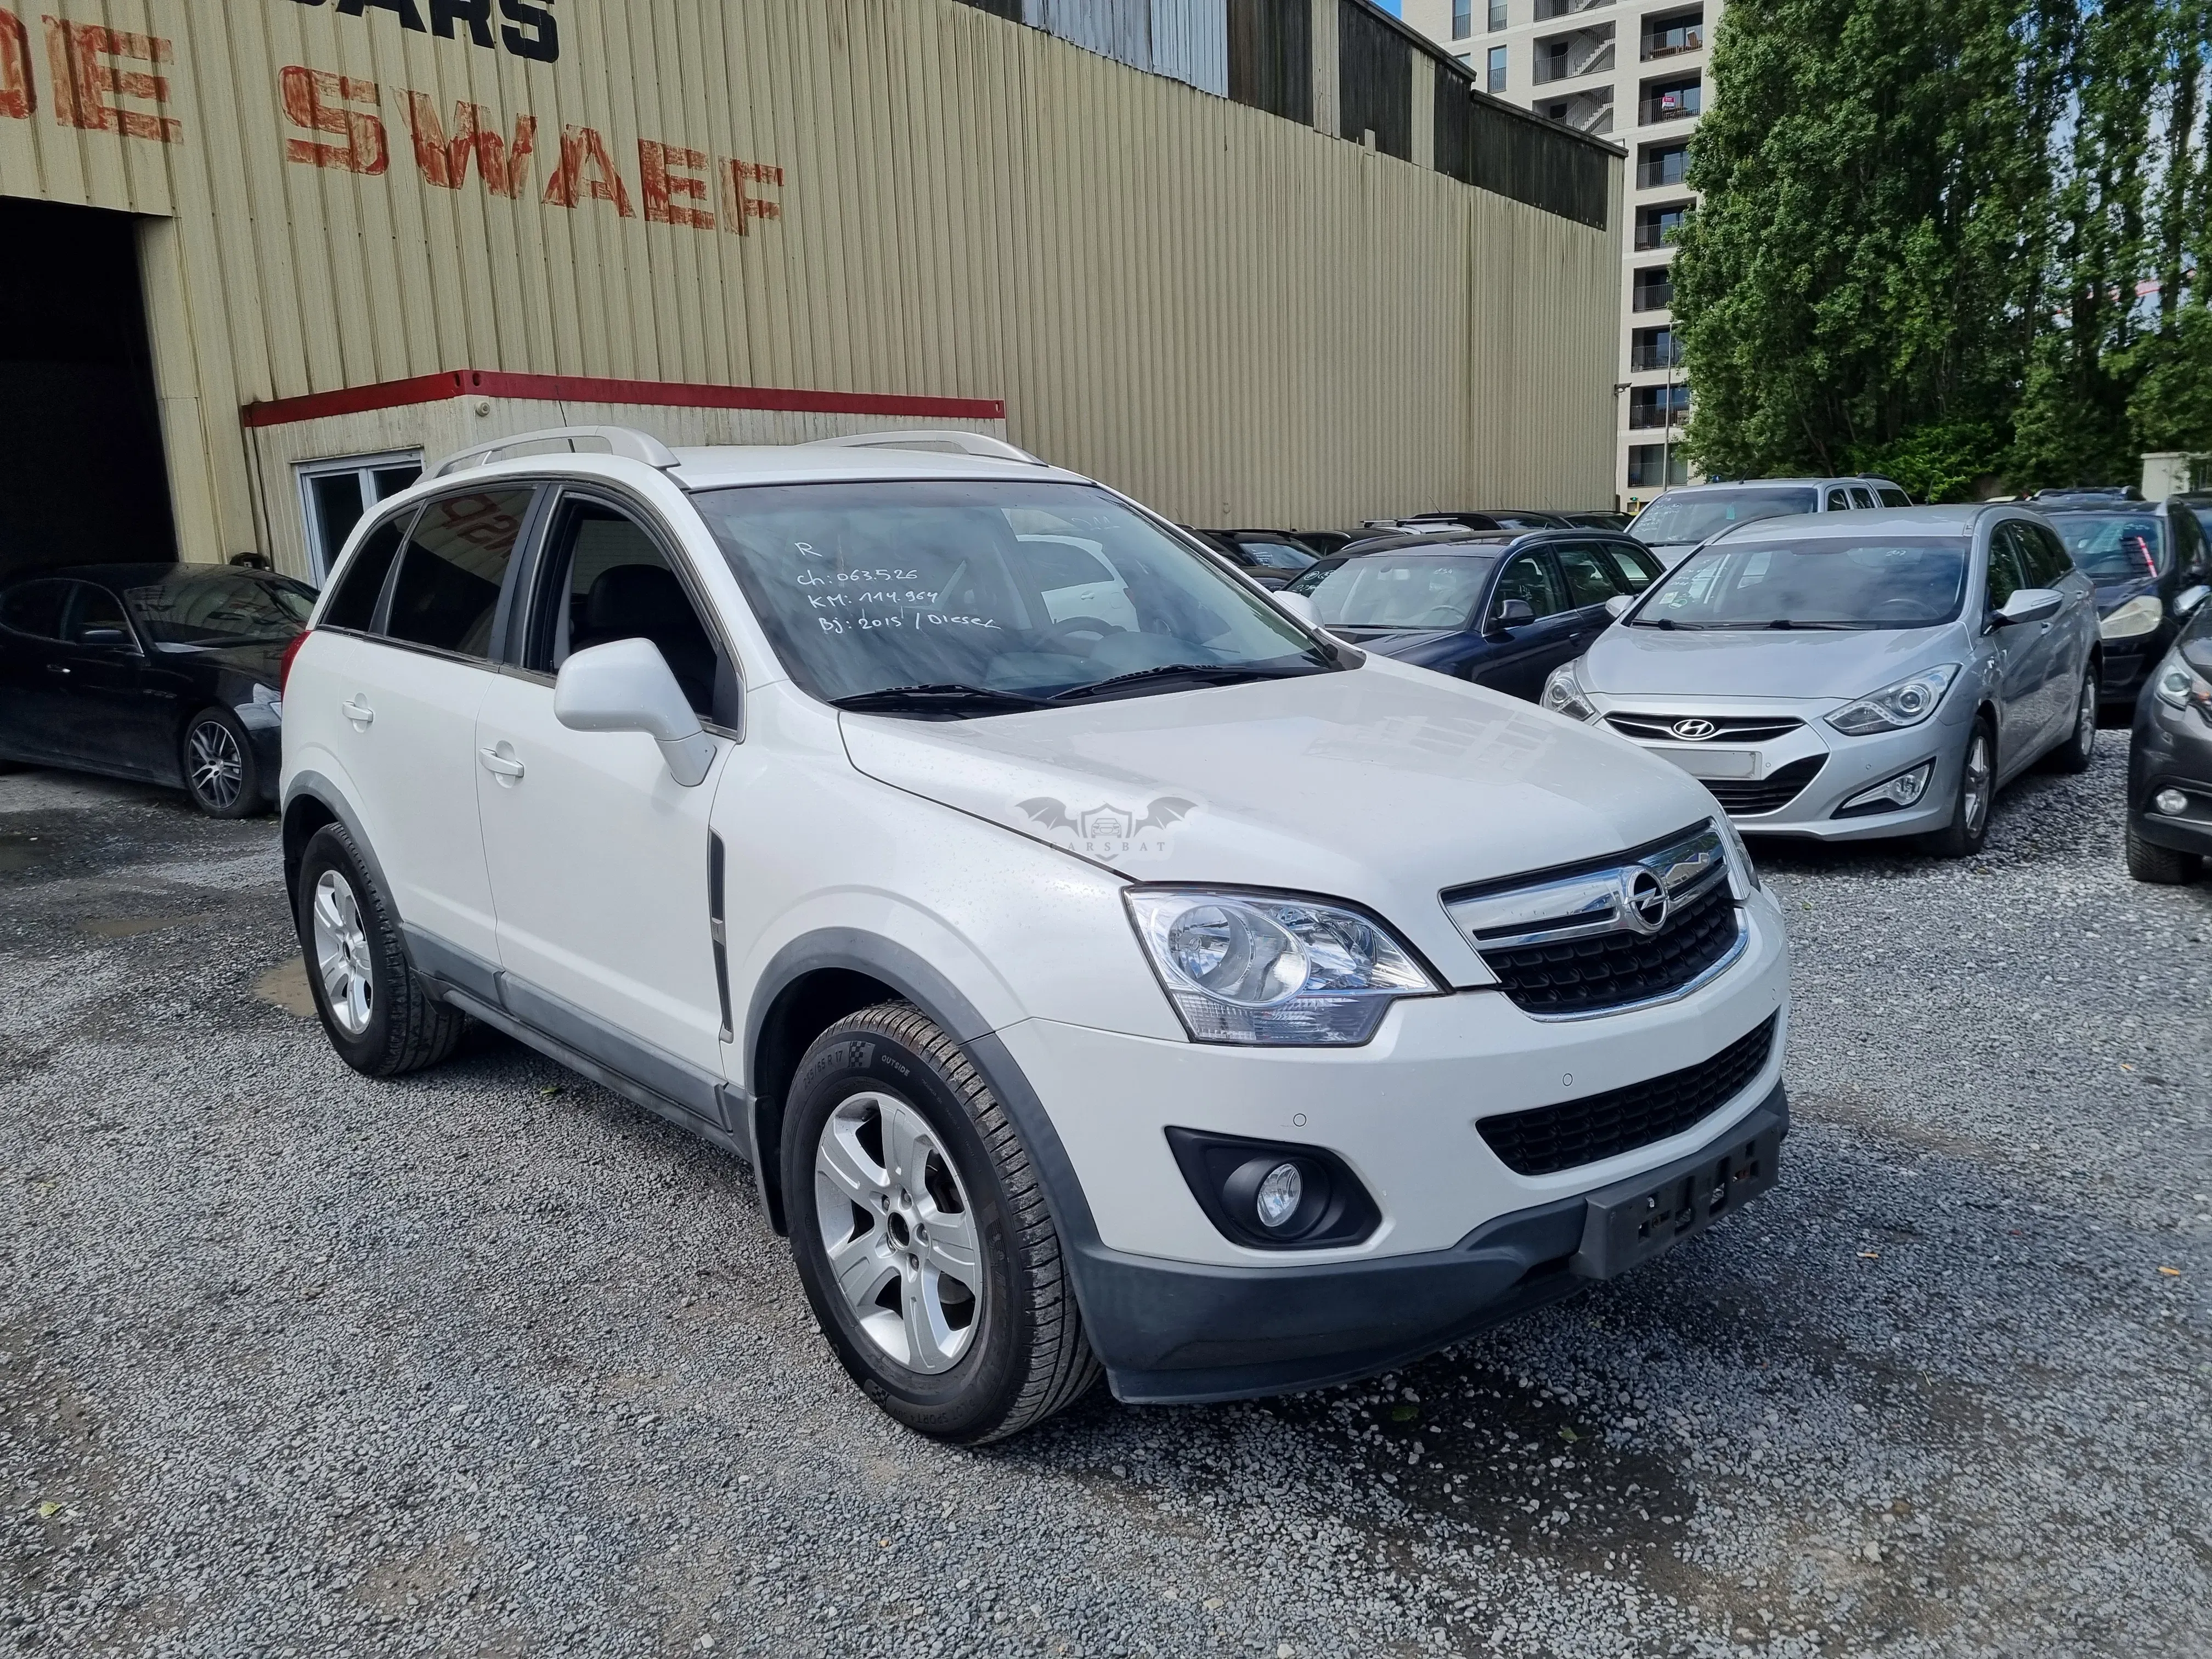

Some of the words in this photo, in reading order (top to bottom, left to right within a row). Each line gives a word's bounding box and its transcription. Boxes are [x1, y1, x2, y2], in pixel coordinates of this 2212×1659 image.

[278, 64, 785, 237] SWAEF
[794, 541, 823, 557] R
[858, 616, 902, 630] 2015
[881, 1054, 911, 1077] OUTSIDE
